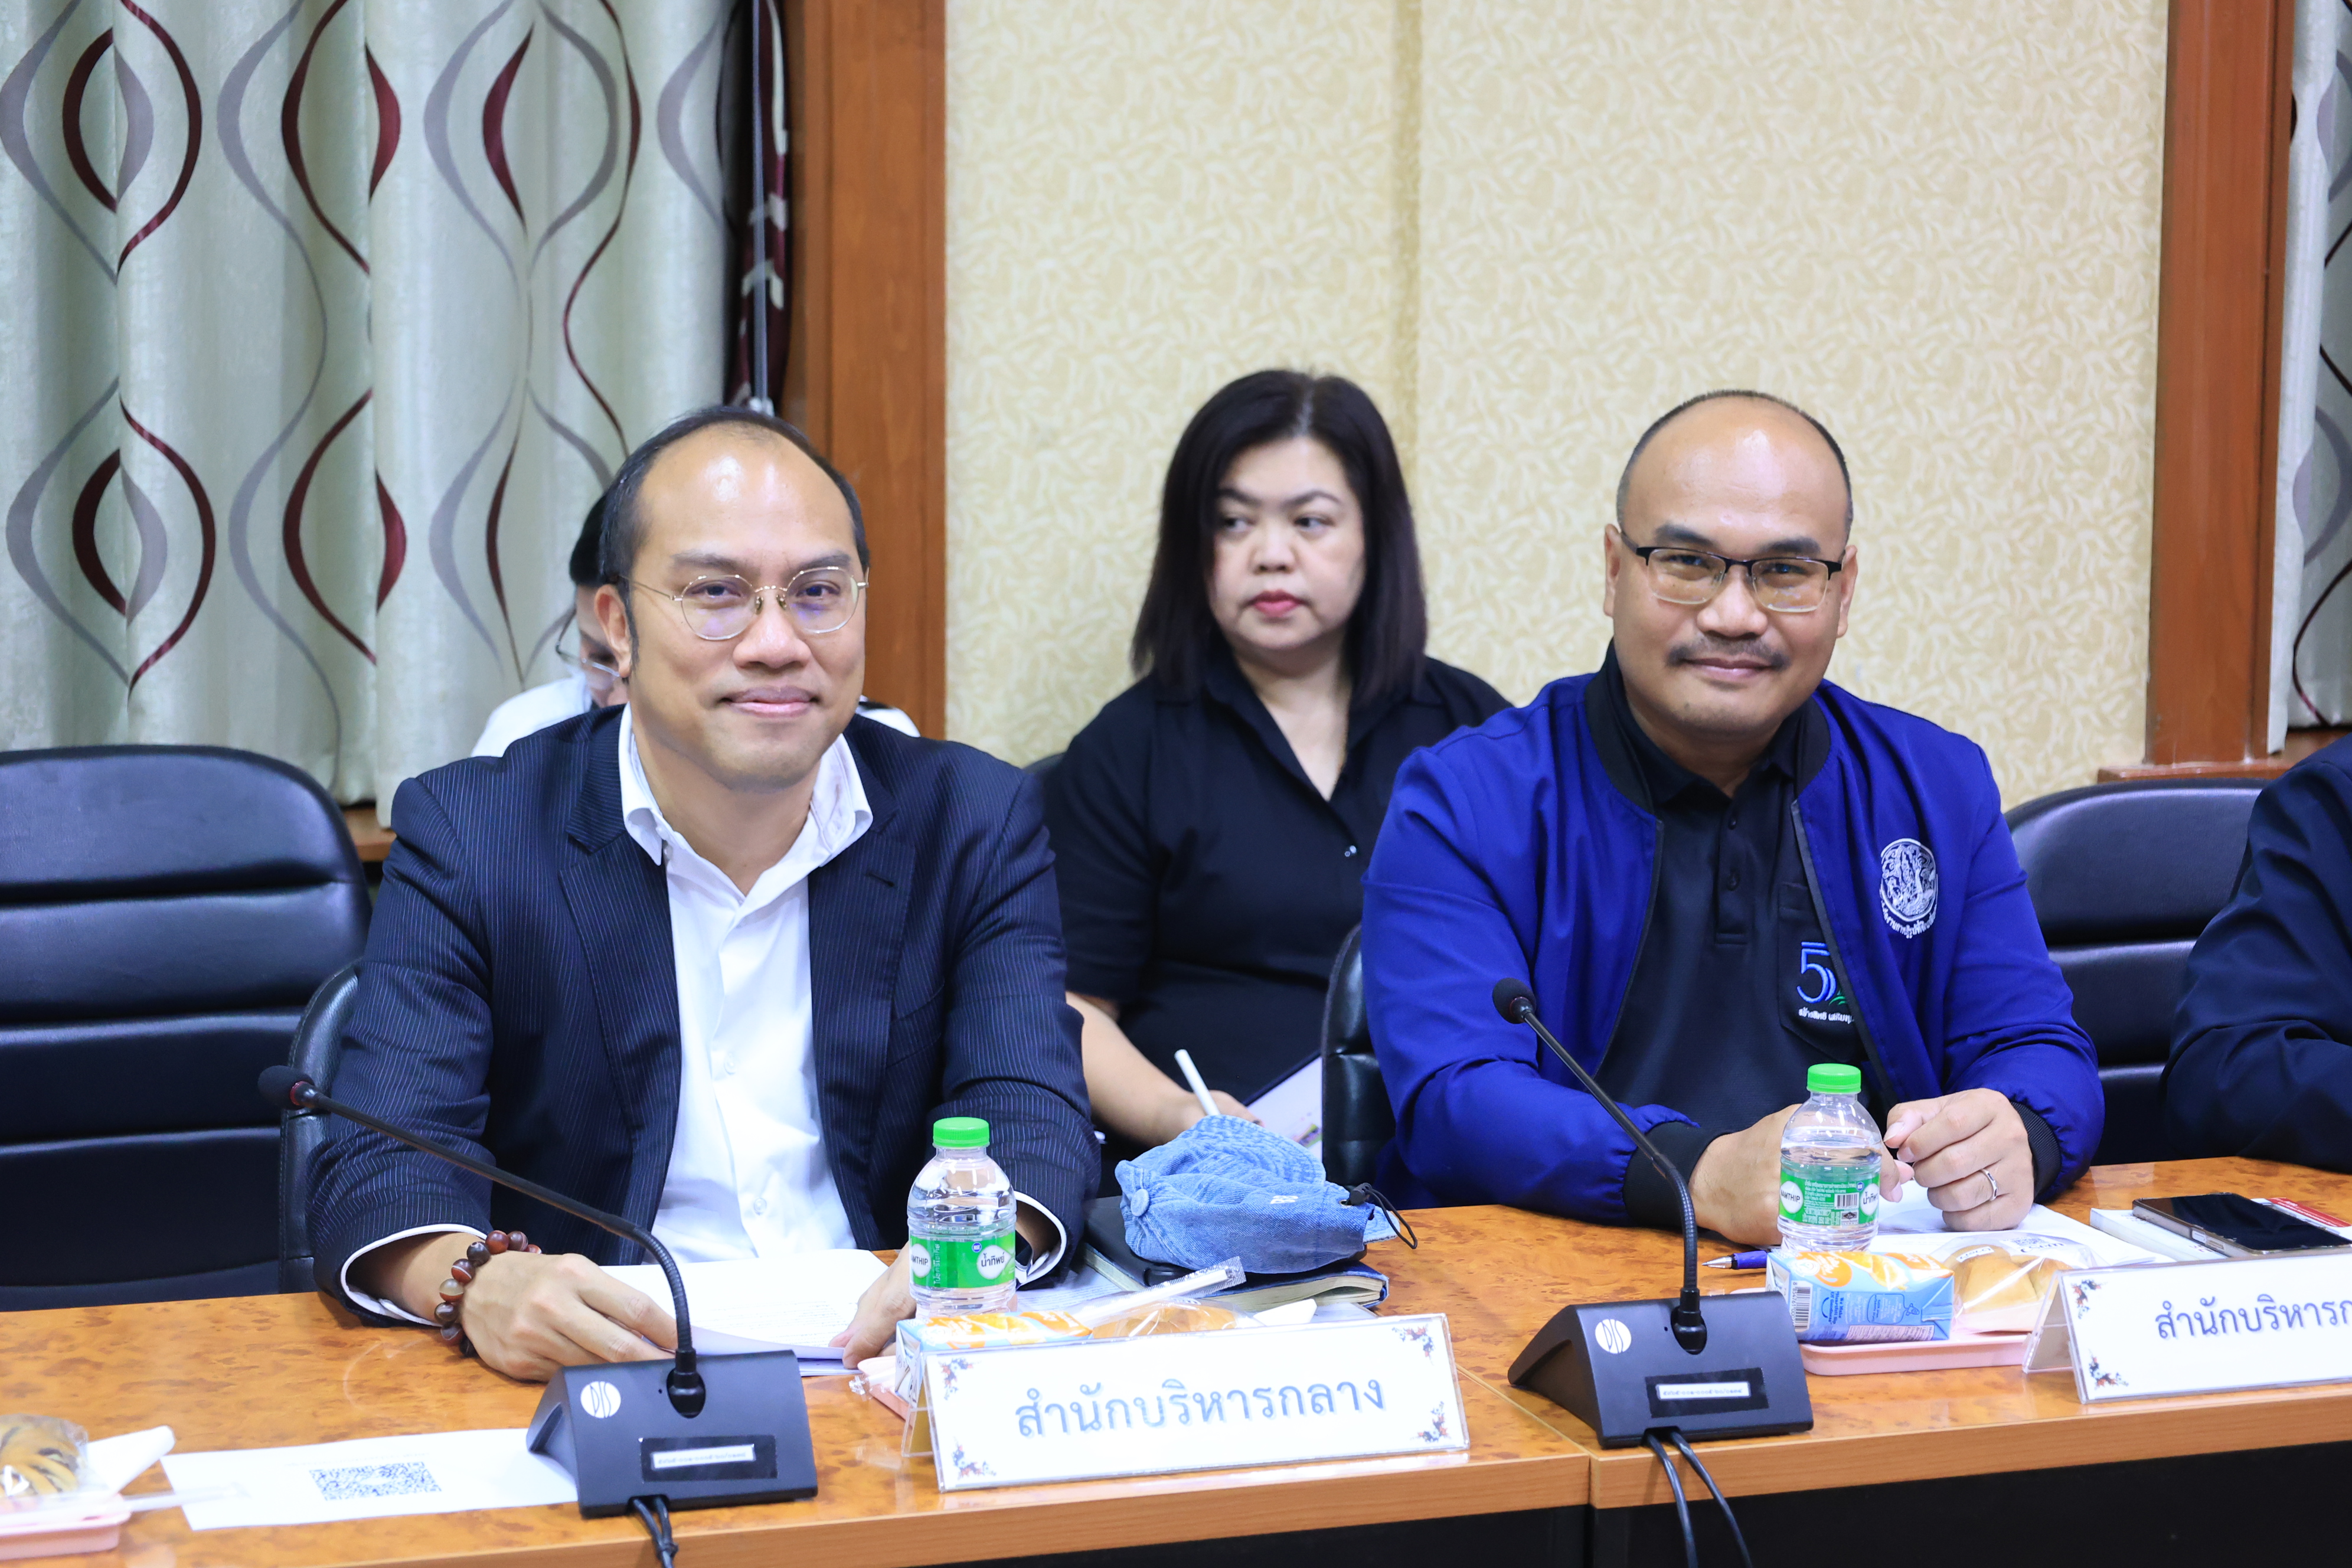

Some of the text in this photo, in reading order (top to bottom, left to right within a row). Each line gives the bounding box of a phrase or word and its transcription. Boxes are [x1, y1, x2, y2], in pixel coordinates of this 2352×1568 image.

[1863, 1191, 1879, 1205] น้ำทิพ
[911, 1254, 929, 1265] AMTHIP
[981, 1251, 1005, 1267] น้ำทิพย์
[2155, 1293, 2352, 1339] สำนักบริหารก
[1015, 1378, 1386, 1437] สำนักบริหารกลาง
